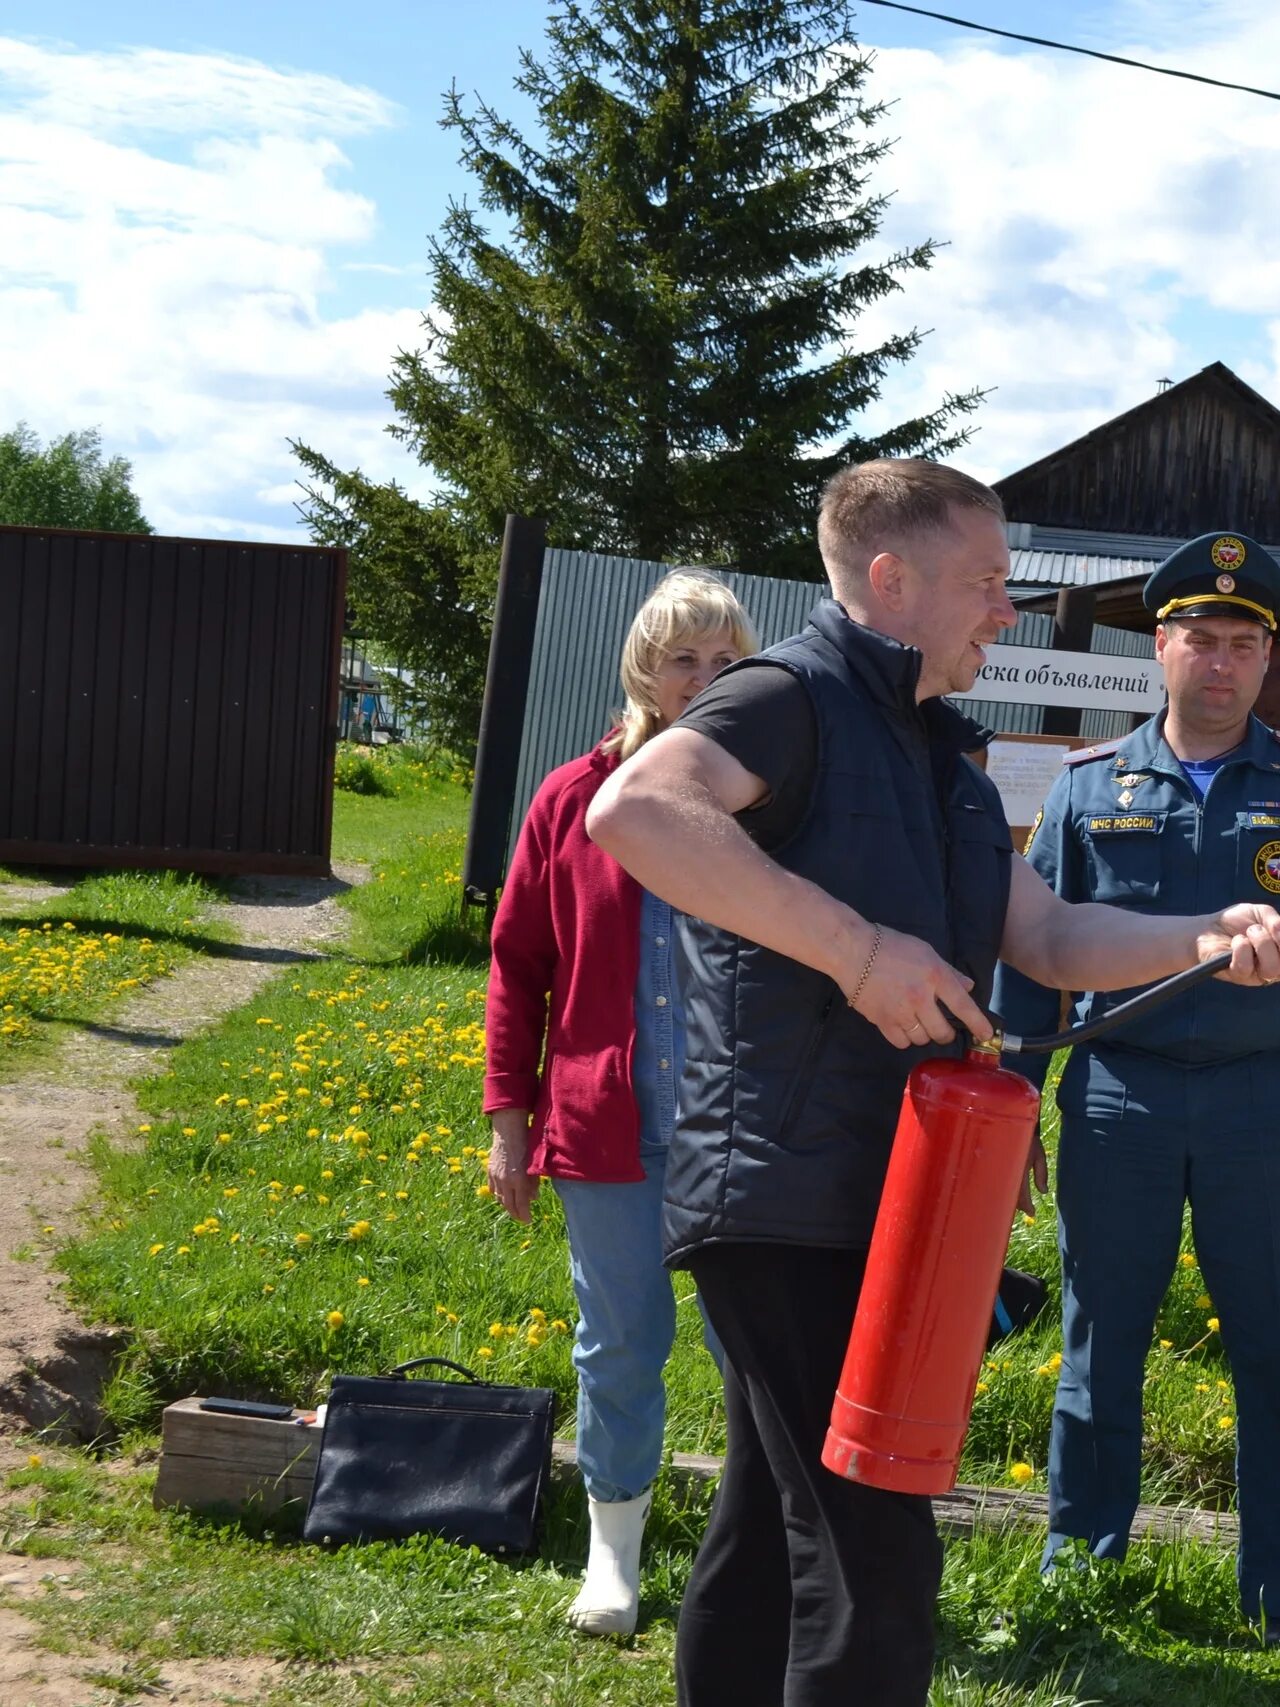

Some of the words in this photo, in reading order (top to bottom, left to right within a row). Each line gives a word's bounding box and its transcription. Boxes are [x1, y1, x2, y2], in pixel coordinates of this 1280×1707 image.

[1025, 664, 1149, 693] объявлений
[1090, 818, 1111, 829] МЧС
[1113, 817, 1153, 828] РОССИИ
[1259, 846, 1273, 861] МЧС
